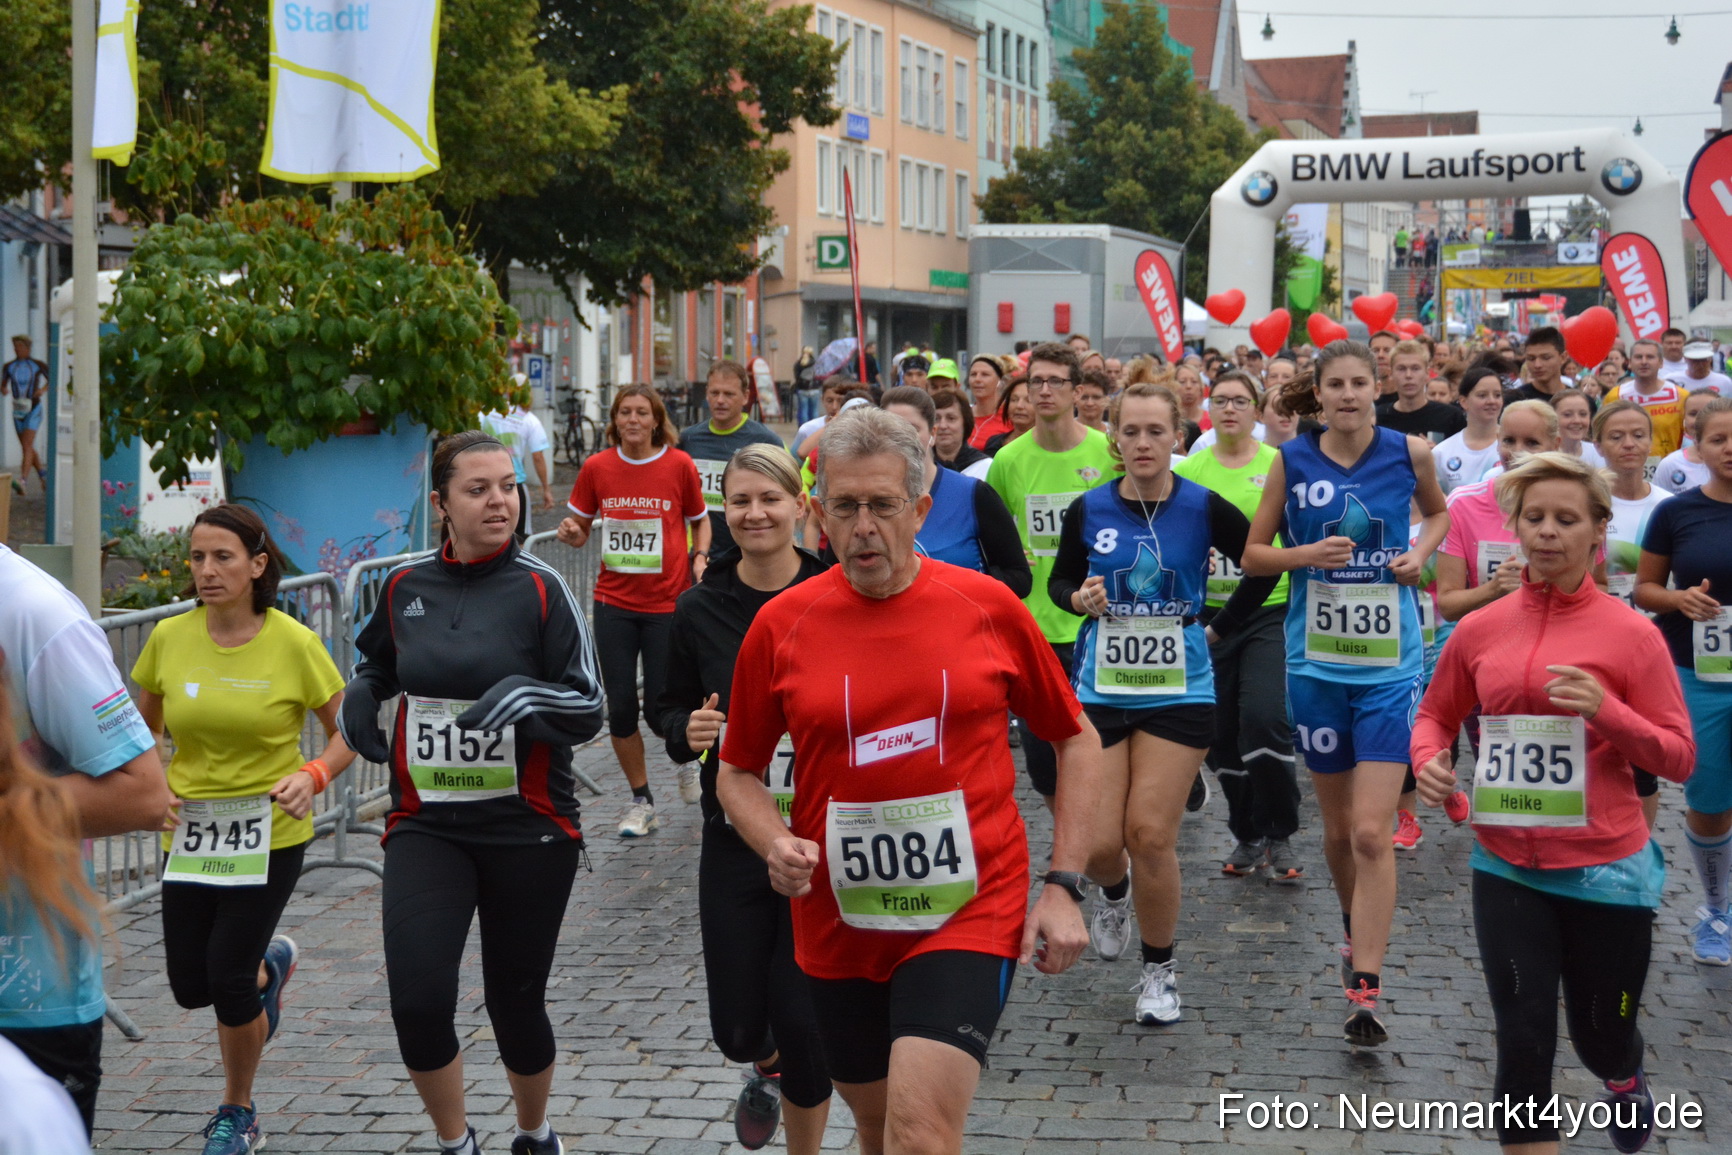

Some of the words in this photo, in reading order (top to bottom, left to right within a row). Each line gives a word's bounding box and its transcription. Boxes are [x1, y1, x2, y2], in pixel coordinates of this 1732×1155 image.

[1291, 151, 1391, 181] BMW
[1402, 145, 1586, 183] Laufsport
[821, 240, 846, 264] D
[1503, 271, 1540, 285] ZIEL
[530, 361, 541, 376] P
[602, 497, 661, 509] NEUMARKT
[1292, 479, 1335, 509] 10
[609, 531, 657, 552] 5047
[1093, 528, 1119, 554] 8
[621, 557, 641, 566] Anita
[1332, 570, 1375, 579] BASKETS
[403, 609, 425, 617] adidas
[1315, 602, 1391, 634] 5138
[1105, 636, 1177, 665] 5028
[1335, 640, 1368, 655] Luisa
[1115, 671, 1166, 685] Christina
[1514, 719, 1573, 734] BOCK
[416, 722, 505, 763] 5152
[877, 731, 914, 752] DEHN
[1296, 723, 1338, 753] 10
[1485, 742, 1573, 785] 5135
[433, 771, 485, 788] Marina
[212, 798, 262, 816] BOCK
[834, 817, 876, 826] NeuerMarkt
[882, 798, 953, 822] BOCK
[1500, 793, 1543, 812] Heike
[183, 817, 262, 852] 5145
[841, 826, 962, 882] 5084
[201, 860, 236, 874] Hilde
[881, 892, 932, 911] Frank
